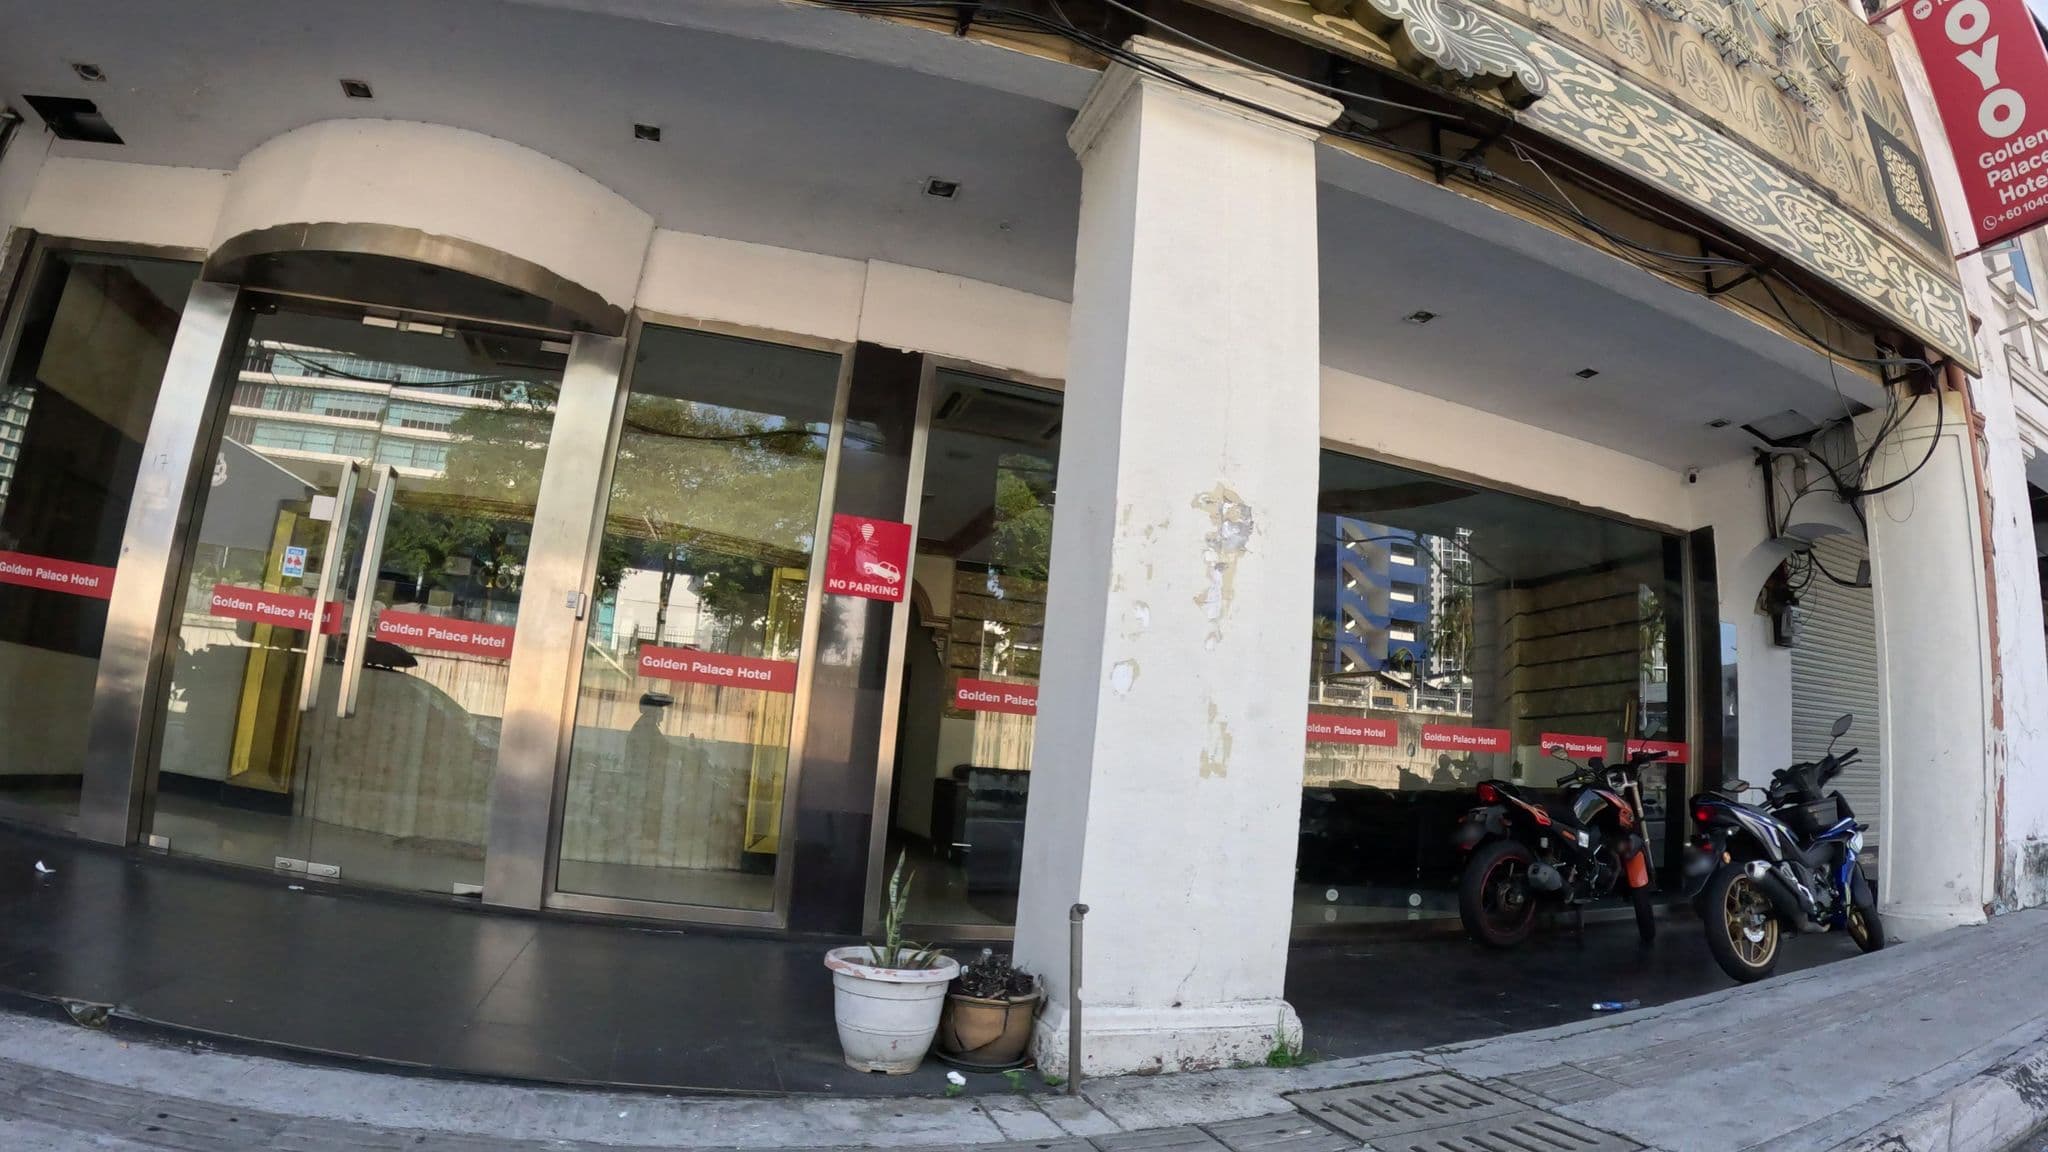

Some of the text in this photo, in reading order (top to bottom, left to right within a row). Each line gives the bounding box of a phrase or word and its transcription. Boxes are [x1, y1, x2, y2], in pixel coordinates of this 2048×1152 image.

[1945, 0, 2026, 138] OYO
[1979, 128, 2048, 169] Golden
[1999, 168, 2048, 205] Hote
[1998, 206, 2022, 222] +60
[0, 562, 99, 588] Golden Palace Hotel
[829, 578, 898, 597] NO PARKING
[212, 595, 331, 623] Golden Palace Hoel
[379, 621, 506, 648] Golden Palace Hotel
[642, 656, 772, 681] Golden Palace Hotel
[958, 689, 1000, 703] Golden
[1306, 723, 1387, 738] olden Palace Hotel
[1424, 732, 1497, 746] Golden Palace Hotel
[1565, 742, 1586, 752] Palace
[1586, 744, 1602, 753] Hotel
